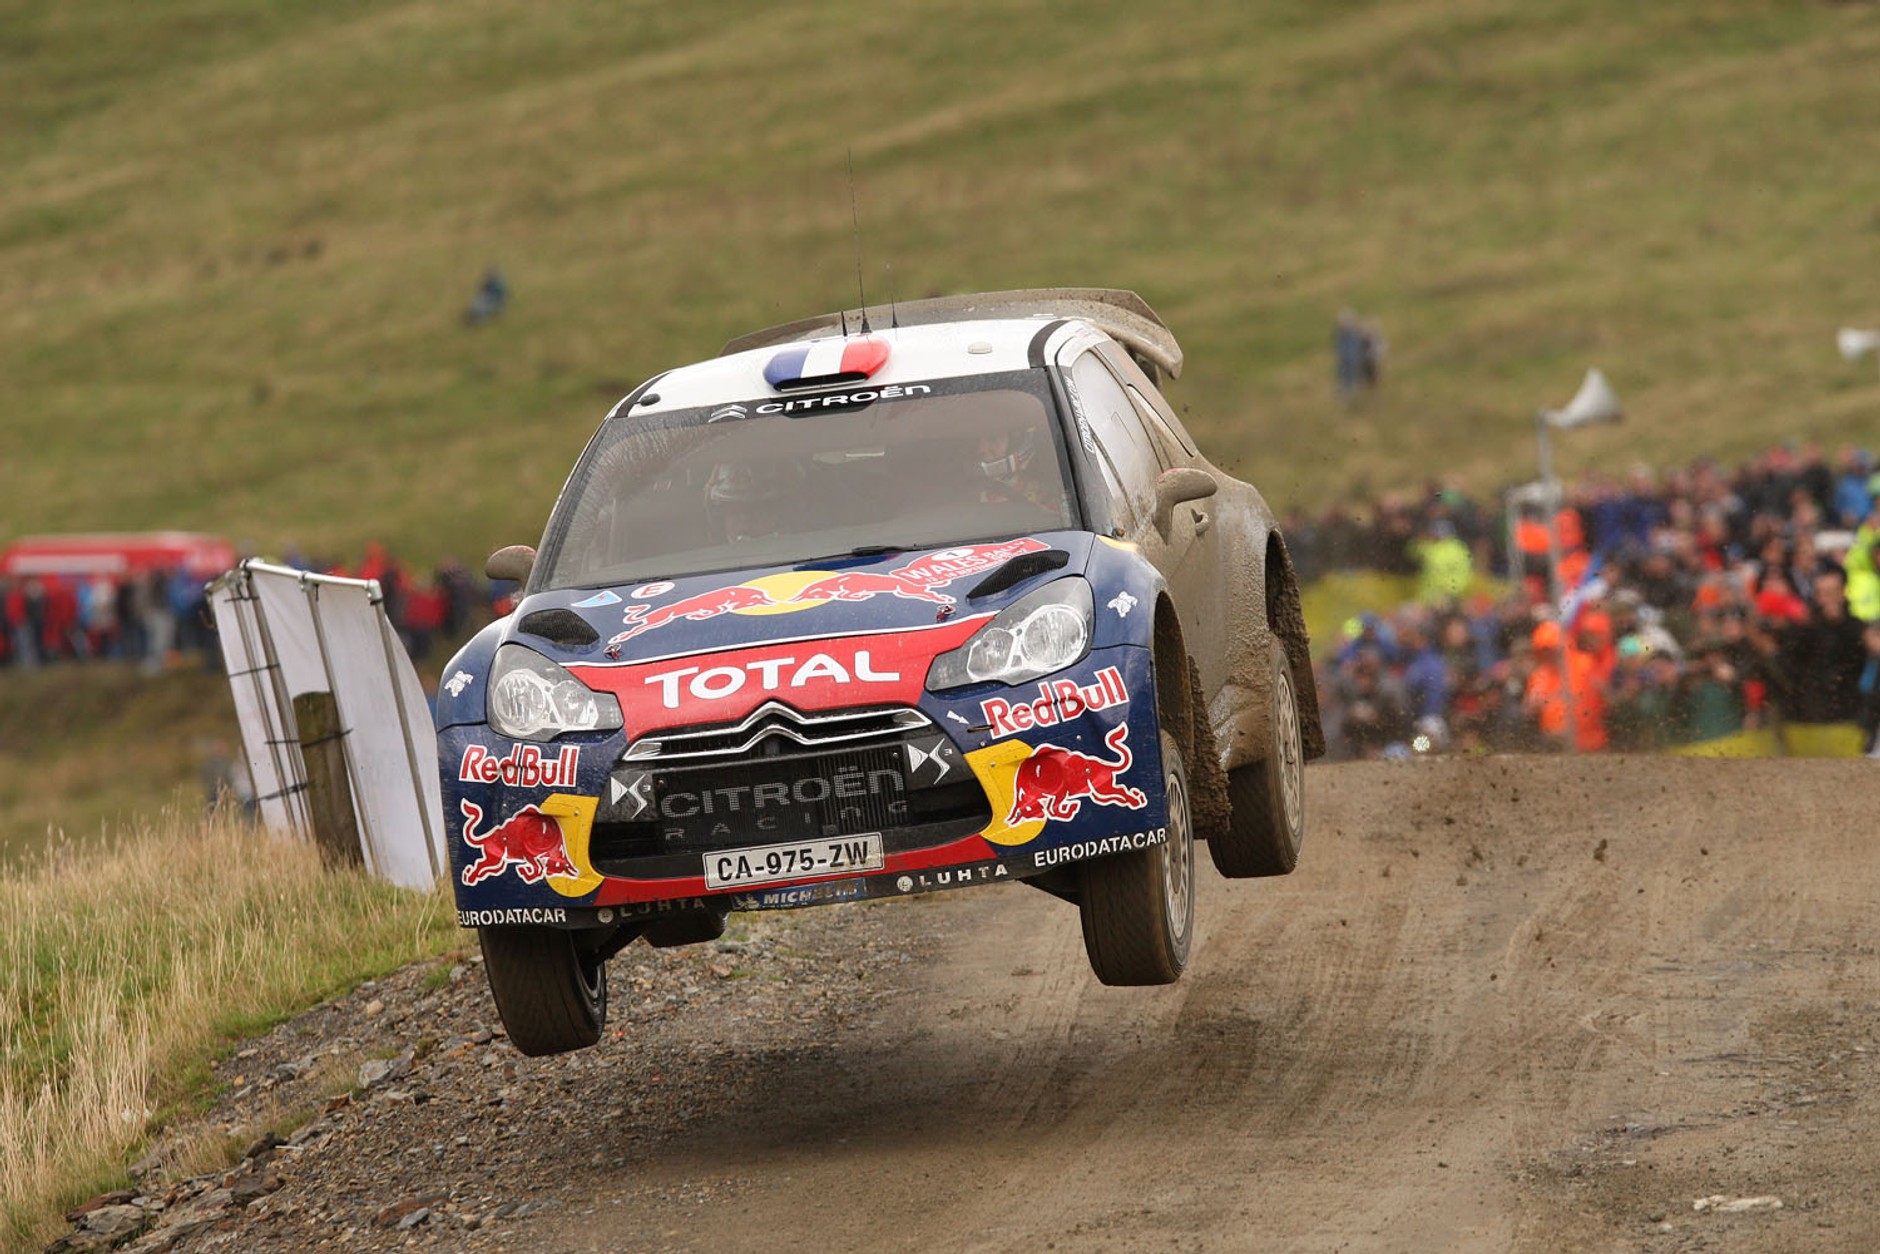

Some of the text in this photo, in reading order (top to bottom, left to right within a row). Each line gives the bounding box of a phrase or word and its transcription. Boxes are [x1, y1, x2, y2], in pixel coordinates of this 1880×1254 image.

[903, 555, 988, 580] WALES
[644, 650, 900, 709] TOTAL
[664, 800, 907, 841] RACING
[717, 841, 869, 881] CA-975-ZW
[1033, 828, 1167, 868] EURODATACAR
[919, 863, 1008, 886] LUHTA
